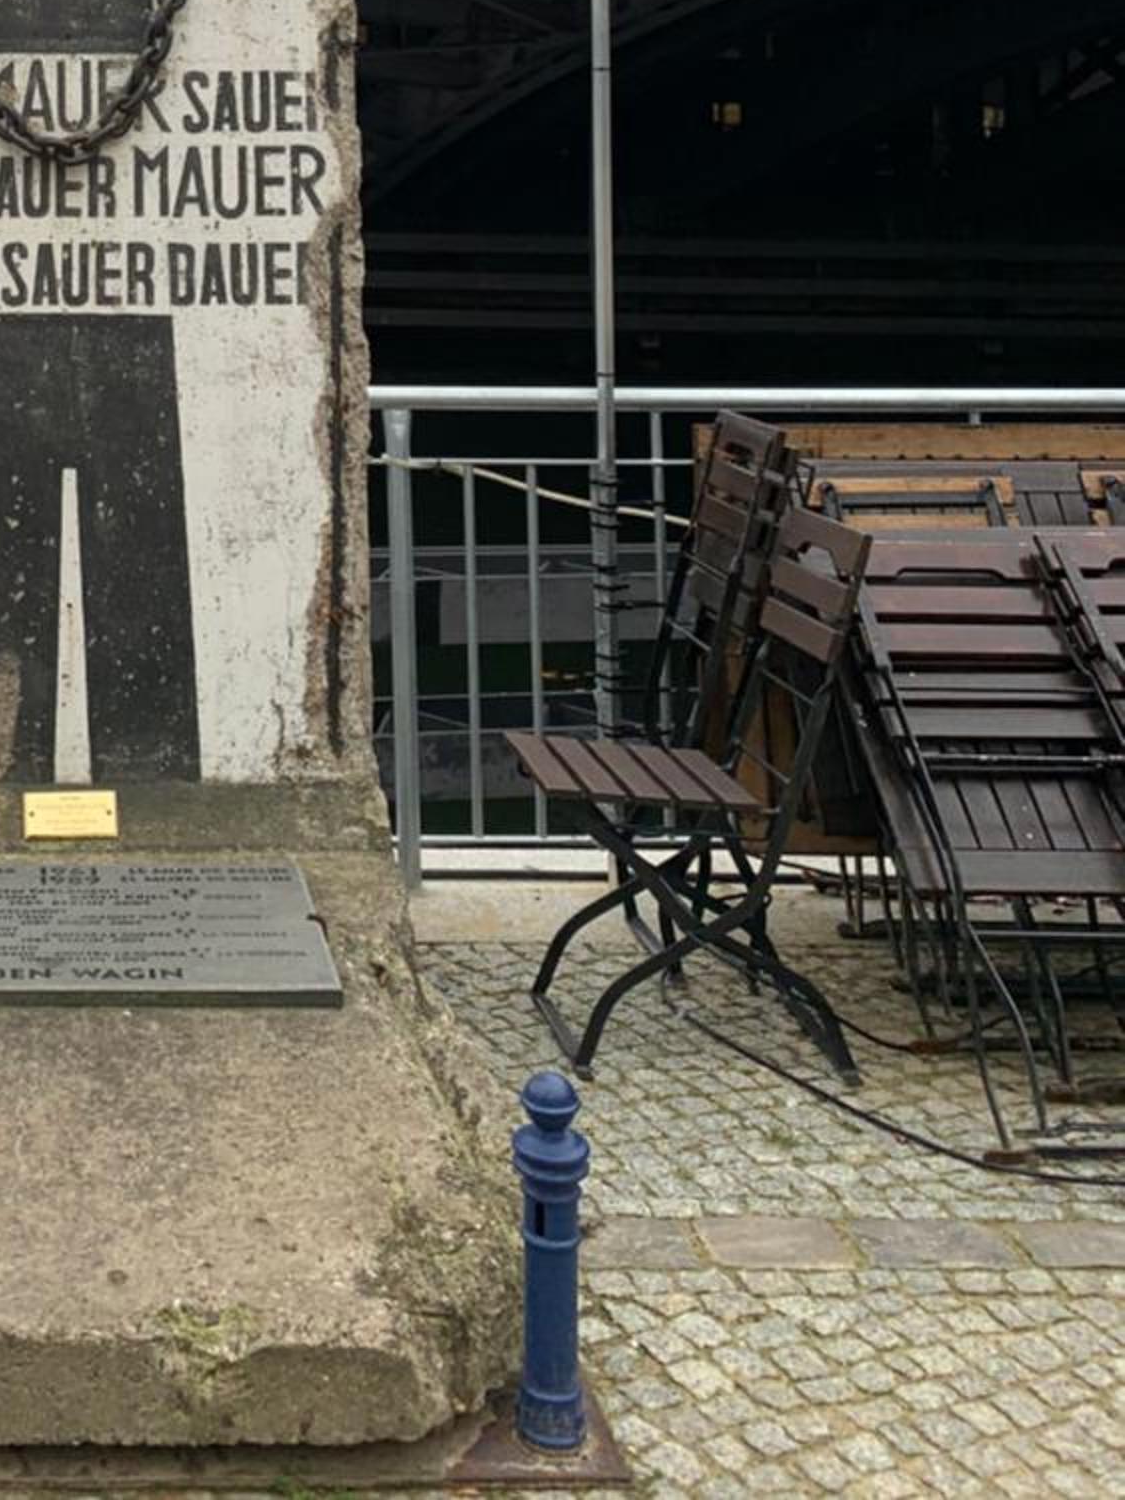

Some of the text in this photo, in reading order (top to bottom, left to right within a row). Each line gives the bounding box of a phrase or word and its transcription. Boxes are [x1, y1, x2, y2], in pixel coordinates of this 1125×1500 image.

[132, 145, 327, 219] MAUER
[1, 242, 155, 307] SAUER
[71, 967, 184, 979] WAGIN
